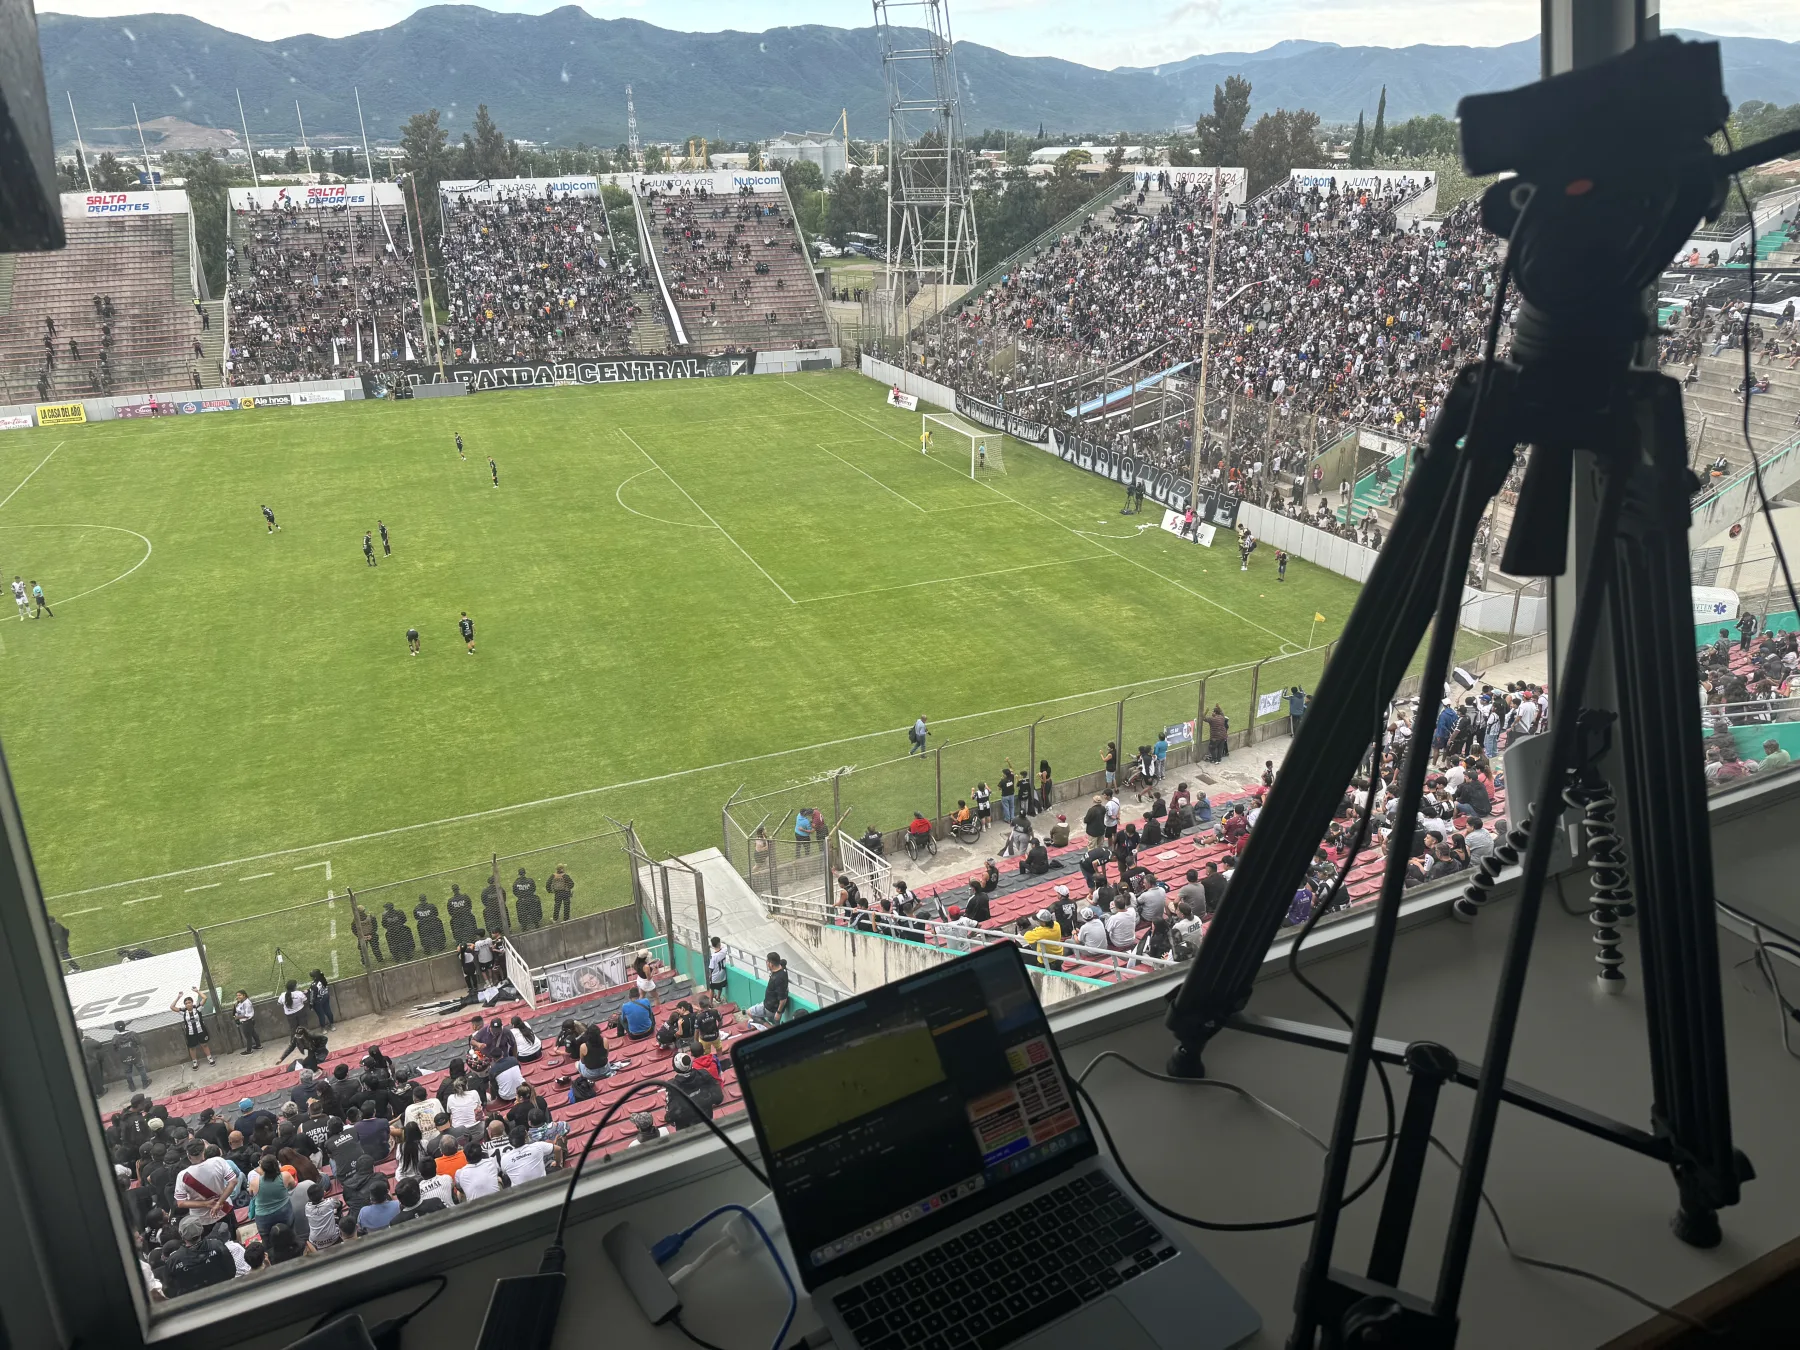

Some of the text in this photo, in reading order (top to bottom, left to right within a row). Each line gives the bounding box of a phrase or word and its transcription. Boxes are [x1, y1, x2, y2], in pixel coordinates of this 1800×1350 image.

[650, 176, 780, 187] JUNTO A VOS Nubicom
[1348, 177, 1379, 187] JUNT
[307, 187, 345, 197] SALTA
[86, 194, 127, 205] SALTA
[88, 202, 150, 213] DEPORTES
[453, 366, 555, 391] BANDA
[554, 363, 577, 380] DE
[577, 358, 707, 385] CENTRAL
[40, 409, 47, 419] LA
[47, 408, 61, 419] CASA
[61, 407, 71, 417] DEL
[994, 408, 1007, 431] DE
[1006, 413, 1041, 441] VERDAD
[1136, 463, 1238, 528] NORTE
[74, 987, 159, 1021] ES
[311, 1132, 328, 1145] 921
[334, 1133, 353, 1145] KAMAL
[420, 1180, 442, 1194] KAMAL
